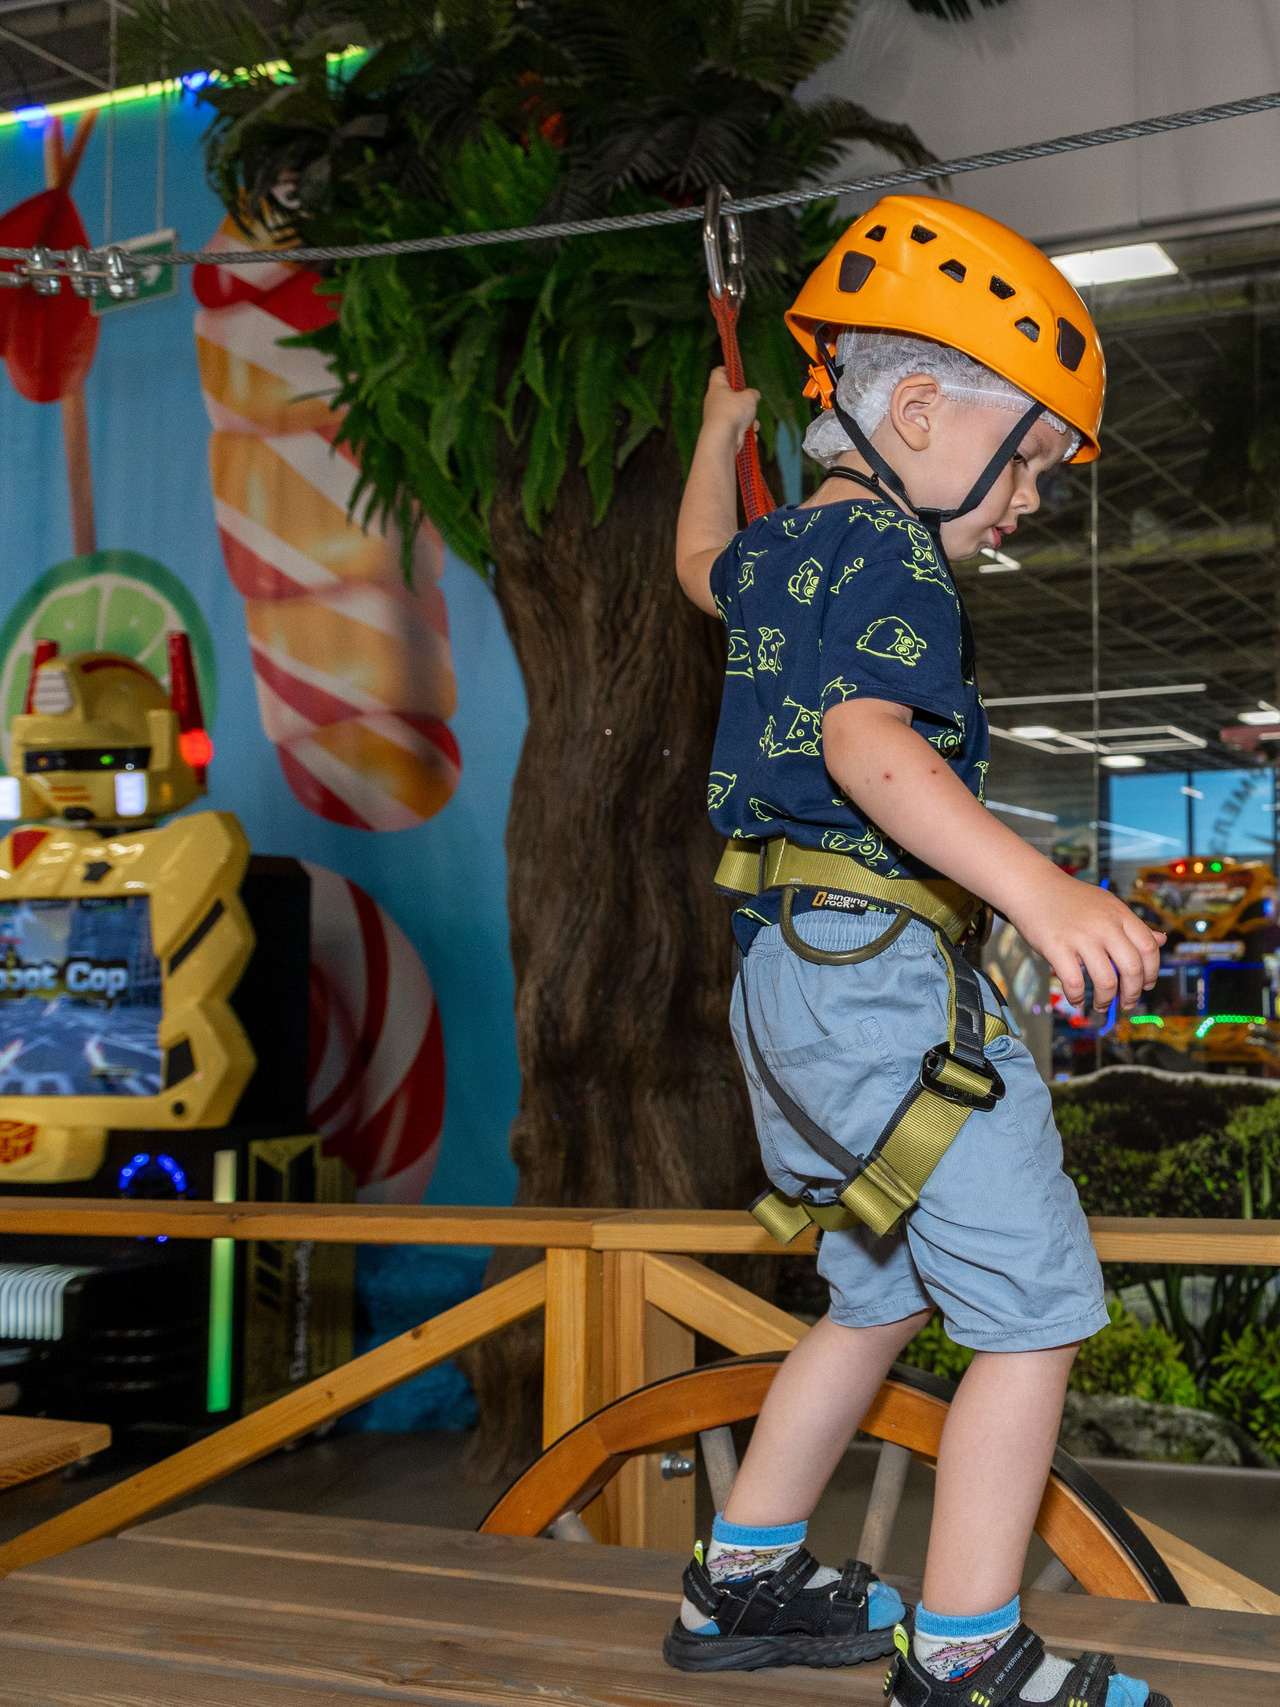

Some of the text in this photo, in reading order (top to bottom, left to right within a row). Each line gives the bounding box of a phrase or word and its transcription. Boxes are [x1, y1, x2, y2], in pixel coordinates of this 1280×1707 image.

[827, 893, 868, 907] singing
[66, 961, 128, 998] Cop
[995, 1672, 1006, 1685] FOR
[1004, 1647, 1024, 1673] EVERYDAY
